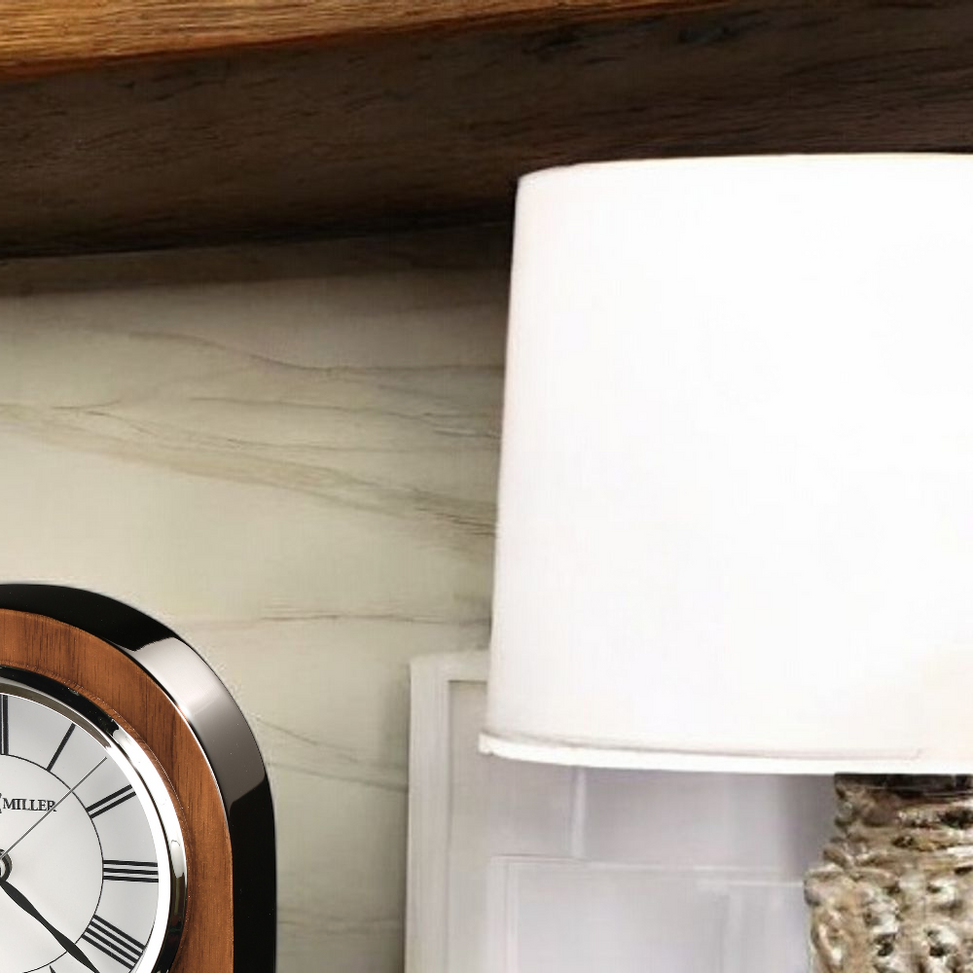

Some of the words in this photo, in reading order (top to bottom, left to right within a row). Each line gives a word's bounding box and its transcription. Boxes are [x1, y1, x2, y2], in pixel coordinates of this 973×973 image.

[2, 797, 57, 812] MILLER
[86, 785, 137, 819] II
[102, 860, 159, 883] III
